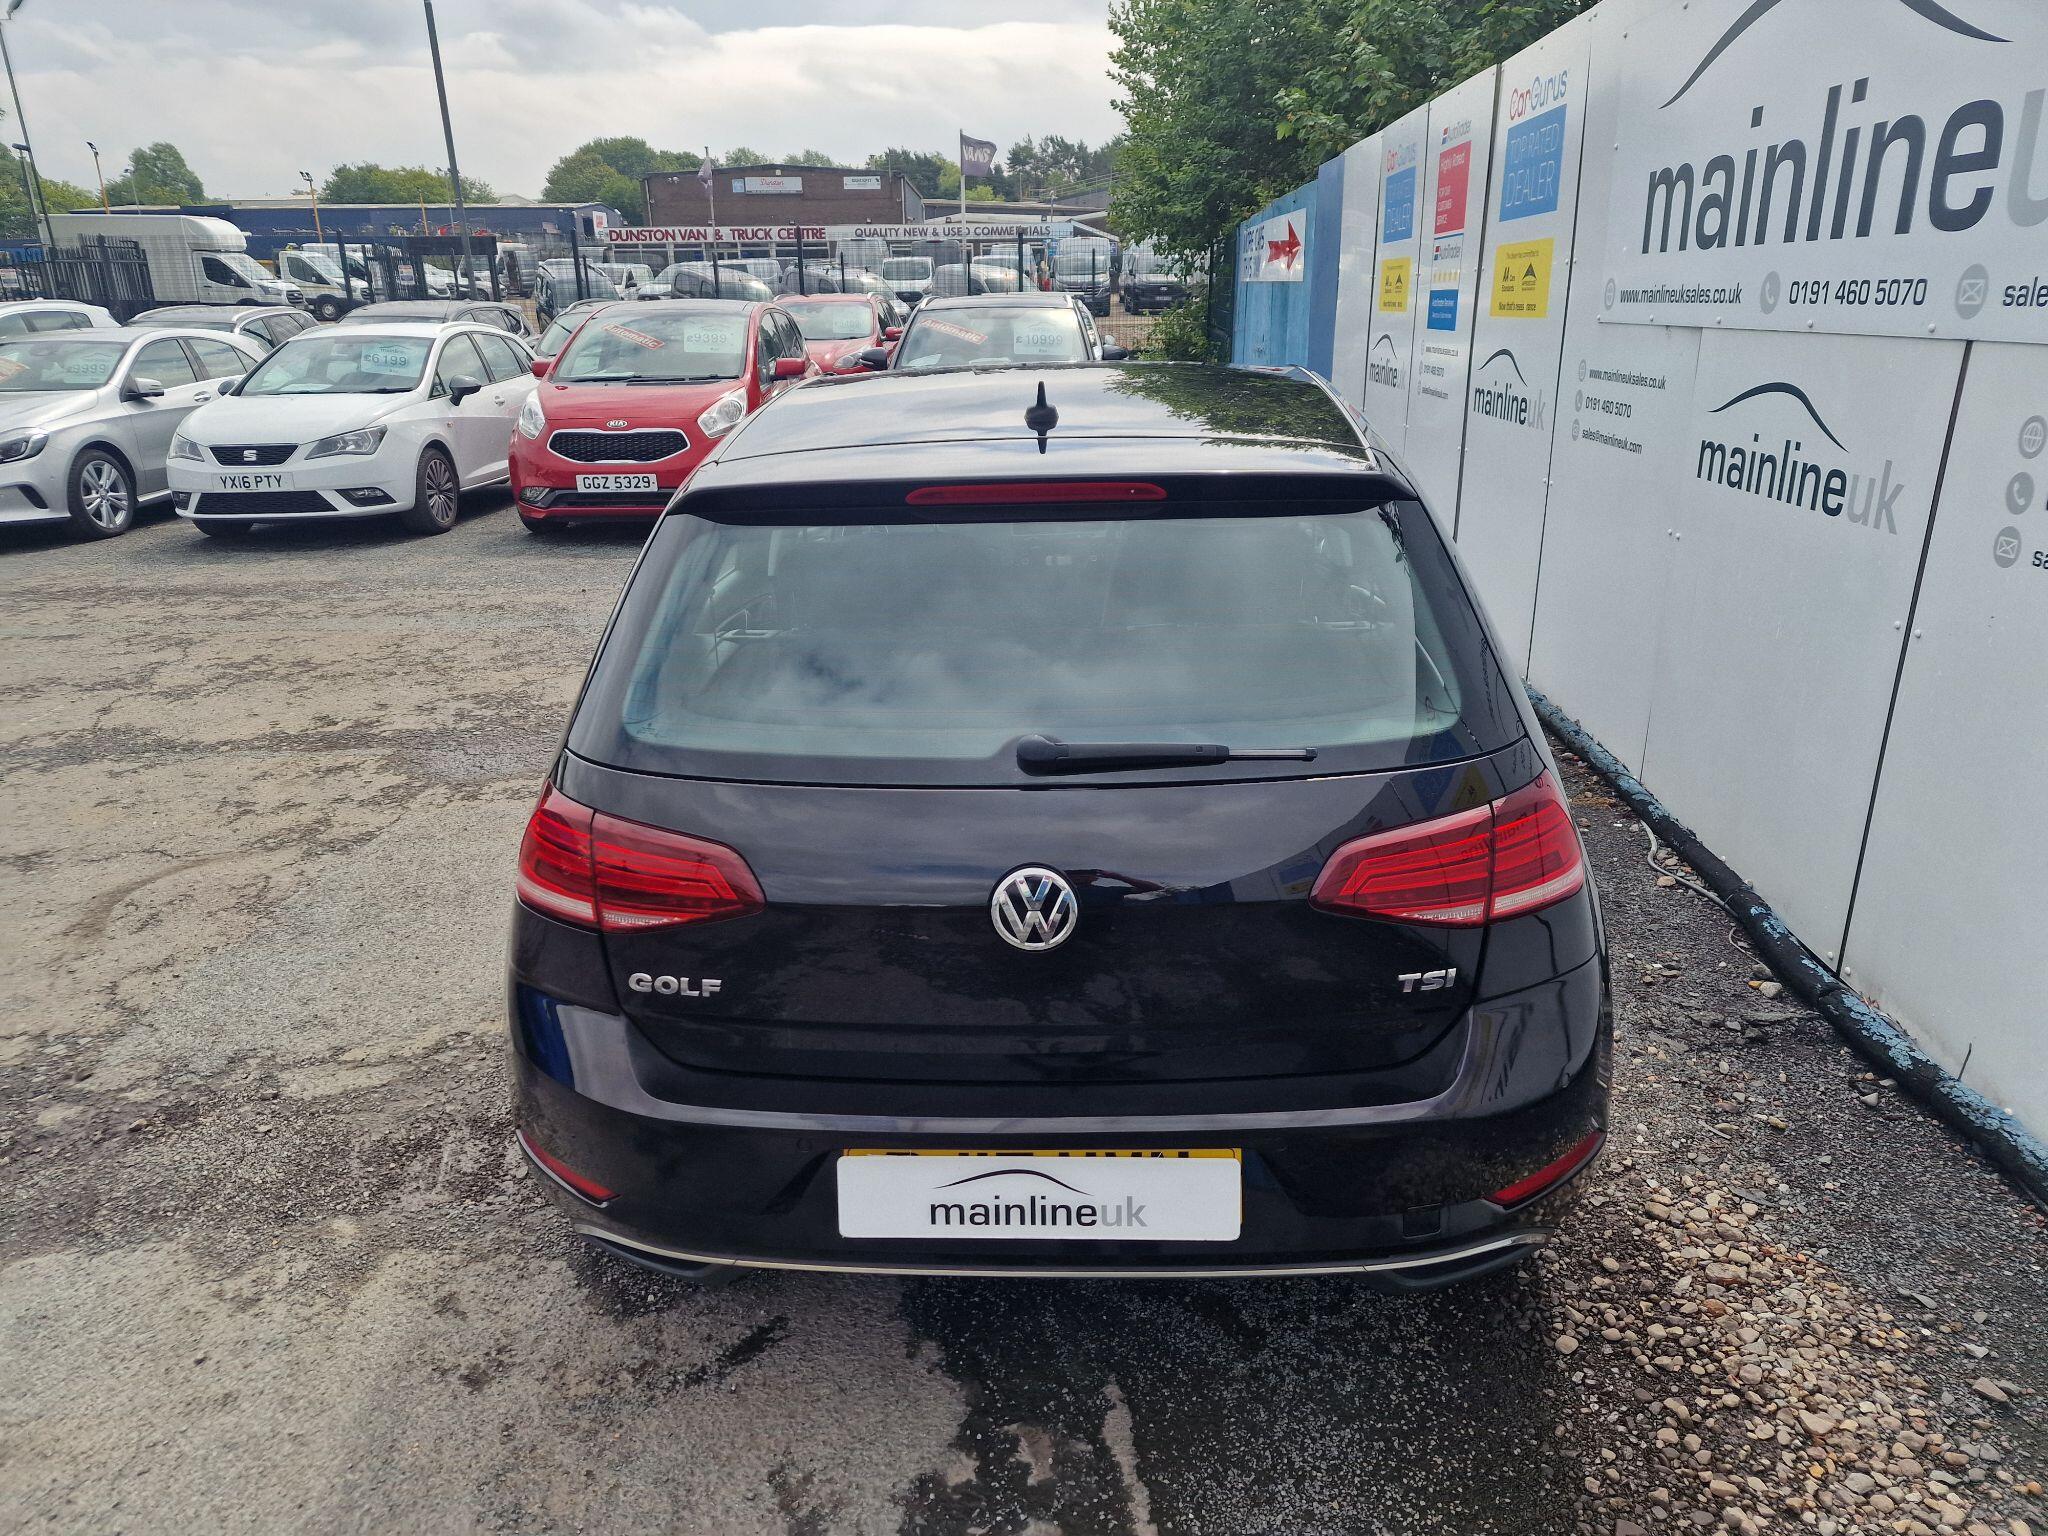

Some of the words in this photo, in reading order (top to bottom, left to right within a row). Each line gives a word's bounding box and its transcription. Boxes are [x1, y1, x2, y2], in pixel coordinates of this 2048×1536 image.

[962, 145, 990, 163] VANS
[1504, 159, 1556, 208] DEALER
[609, 228, 676, 242] DUNSTON
[678, 228, 707, 242] VAN
[715, 229, 724, 241] &
[730, 227, 772, 241] TRUCK
[854, 227, 900, 238] QUALITY
[903, 227, 928, 237] NEW
[931, 227, 940, 237] &
[1620, 282, 1742, 305] www.mainlineuksales.co.uk
[1789, 280, 1830, 305] 0191
[1834, 279, 1871, 306] 460
[1874, 278, 1928, 306] 5070
[604, 323, 659, 349] Automatic
[922, 318, 982, 344] Automatic
[1473, 380, 1546, 431] mainlineuk
[1585, 396, 1600, 412] 0191
[1601, 400, 1614, 415] 460
[1614, 402, 1632, 418] 5070
[220, 475, 251, 489] YX16
[254, 474, 281, 488] PTY
[583, 476, 610, 489] GGZ
[614, 476, 651, 489] 5329
[1697, 432, 1904, 535] mainlineuk
[628, 972, 722, 997] GOLF
[1398, 967, 1457, 993] TSI
[929, 1194, 1148, 1227] mainlineuk
